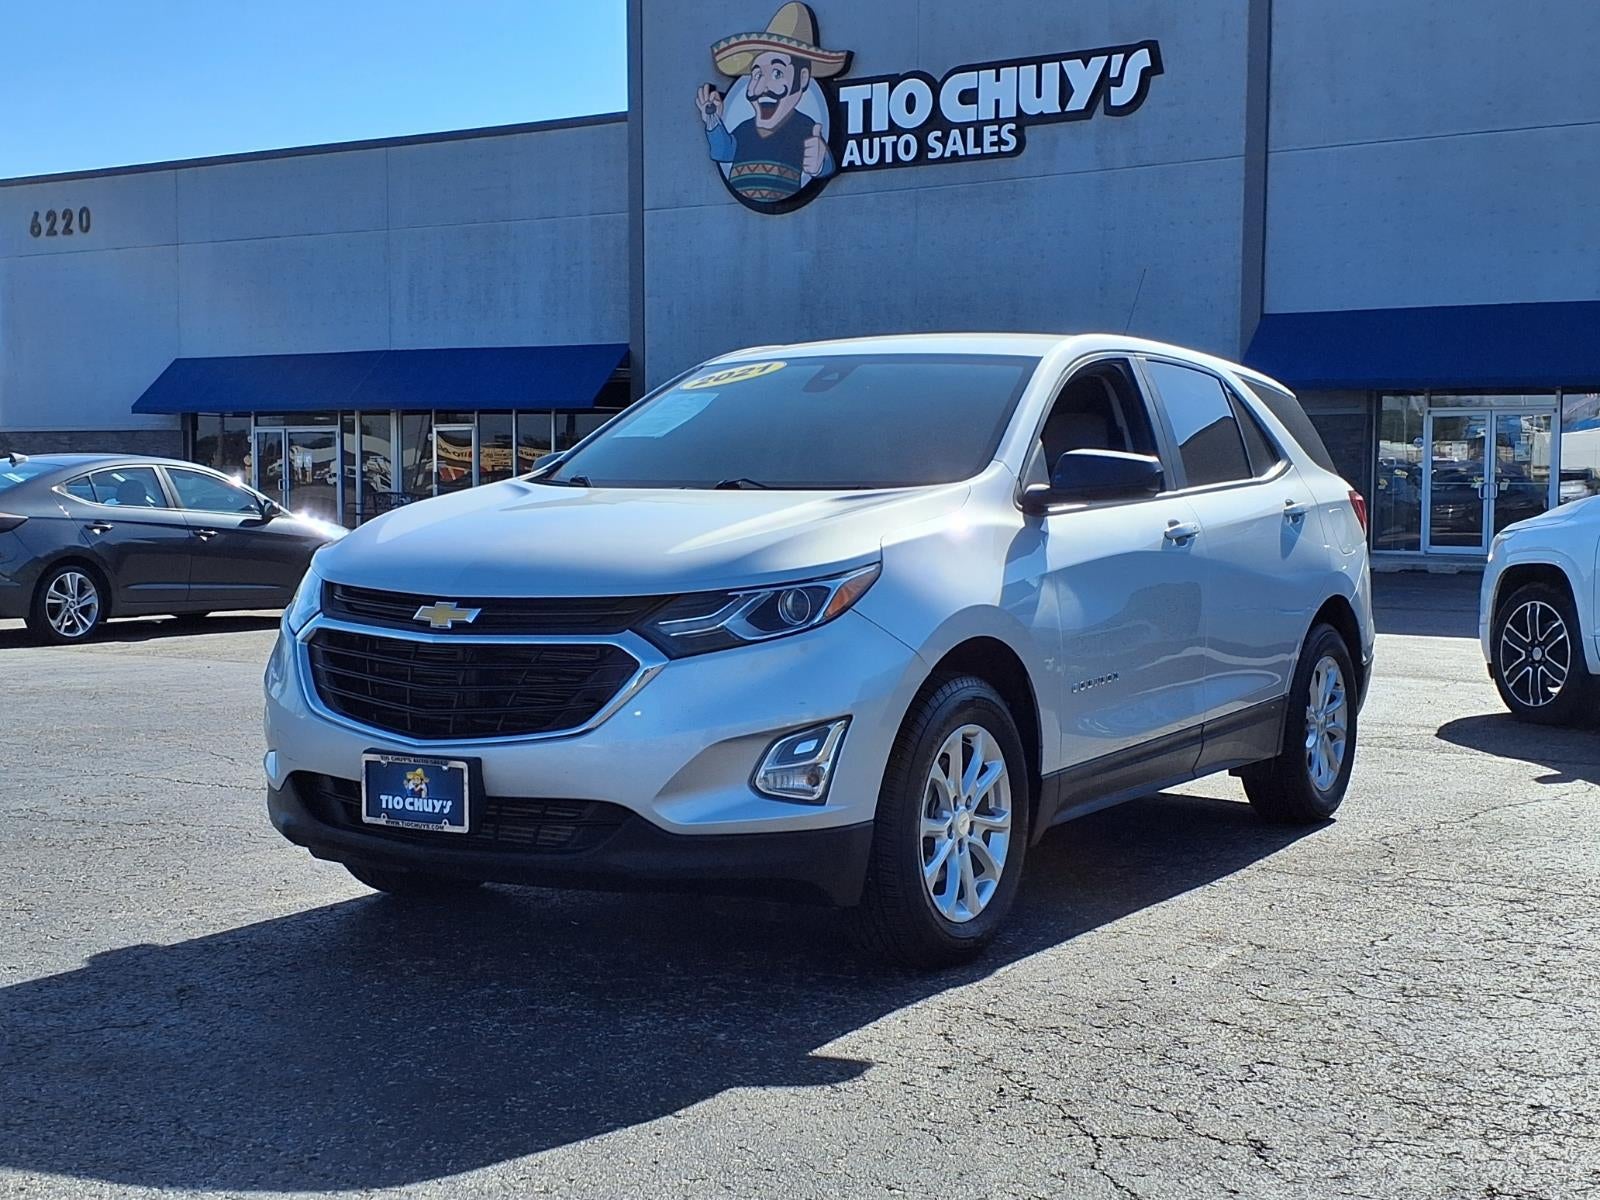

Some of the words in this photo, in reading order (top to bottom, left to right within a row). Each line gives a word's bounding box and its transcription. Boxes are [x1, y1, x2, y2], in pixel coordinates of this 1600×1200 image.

[839, 78, 932, 134] TIO
[940, 47, 1152, 121] CHUY'S
[841, 133, 917, 167] AUTO
[927, 124, 1017, 159] SALES
[30, 206, 91, 238] 6220
[690, 363, 776, 388] 2021
[380, 795, 404, 810] TIO
[405, 797, 453, 814] CHUY'S
